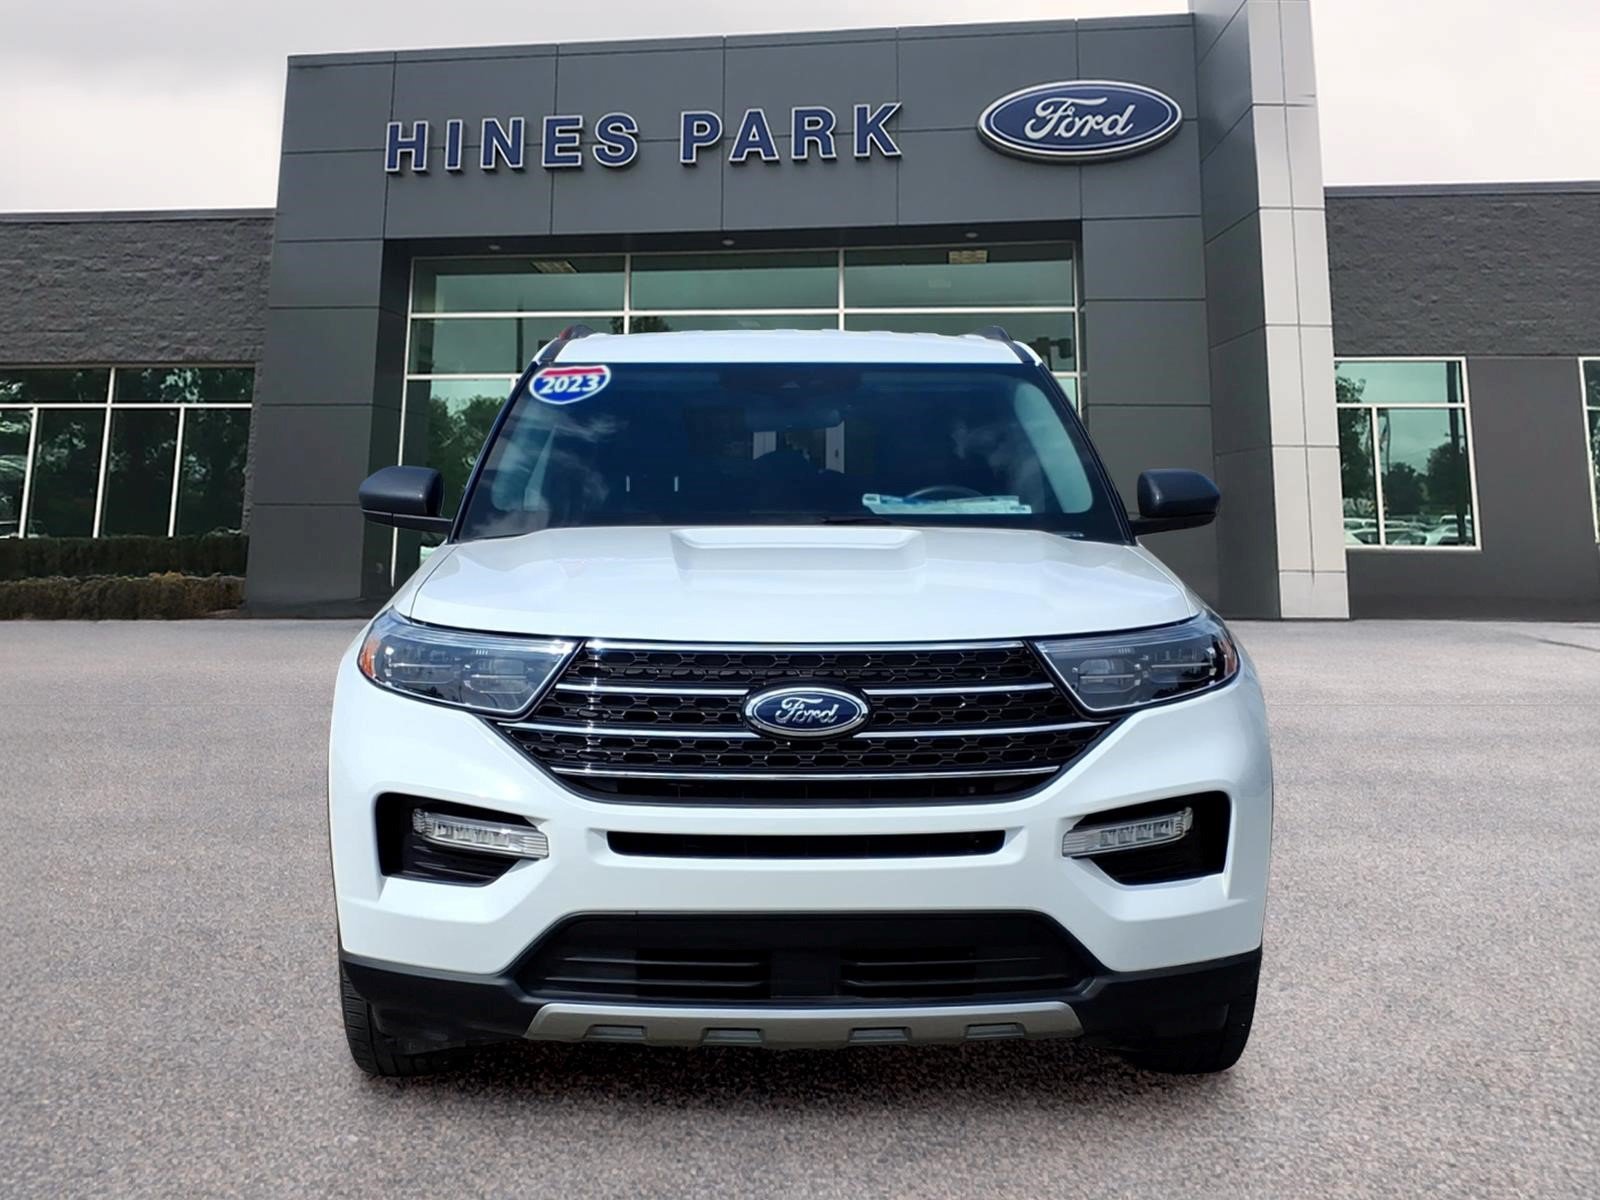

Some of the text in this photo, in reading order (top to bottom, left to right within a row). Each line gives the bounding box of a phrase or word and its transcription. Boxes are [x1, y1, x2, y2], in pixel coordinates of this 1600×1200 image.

[1024, 97, 1136, 140] Ford
[385, 103, 902, 172] HINES PARK
[539, 374, 600, 394] 2023
[775, 697, 839, 724] Ford
